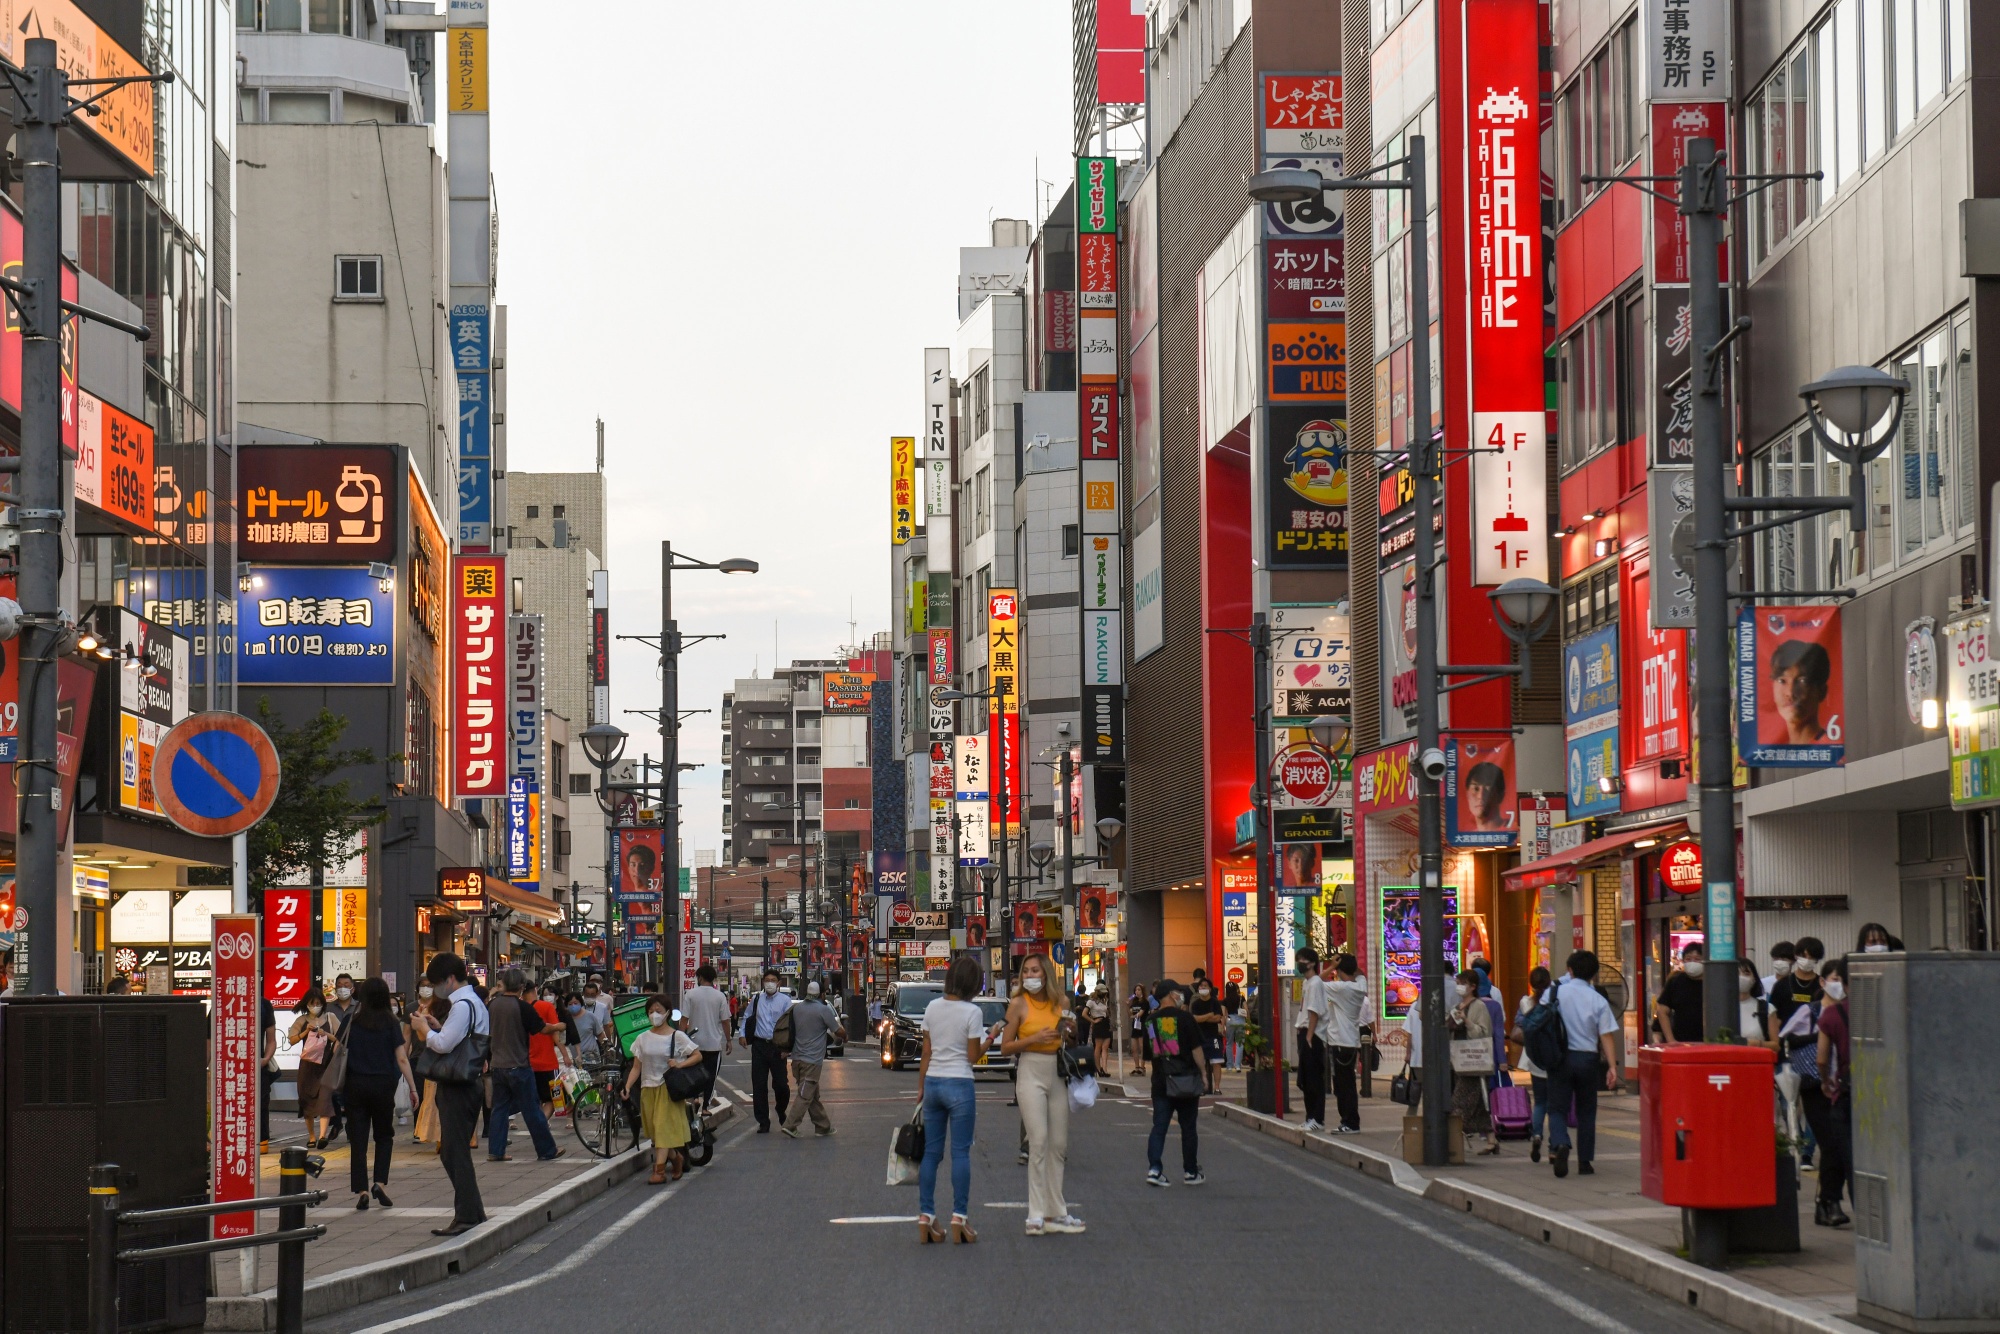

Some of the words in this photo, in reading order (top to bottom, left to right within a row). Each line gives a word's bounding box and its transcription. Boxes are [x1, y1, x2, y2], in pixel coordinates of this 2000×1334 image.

[459, 31, 474, 111] 大宮中央クリニック
[1702, 51, 1716, 87] 5F
[1478, 128, 1490, 210] TAITO
[1088, 161, 1106, 231] サイゼリヤ
[1492, 128, 1531, 328] GAME
[1085, 237, 1097, 291] バイキング
[1100, 235, 1111, 291] しゃぶしゃぶ
[1273, 247, 1344, 273] ホット
[1479, 214, 1493, 328] STATION
[453, 304, 487, 317] AEON
[1084, 293, 1114, 304] しゃぶ葉
[1083, 345, 1115, 353] コンタクト
[1300, 370, 1346, 392] PLUS
[457, 320, 483, 512] 英会話イーオン
[931, 404, 945, 451] TRN
[1090, 394, 1109, 455] ガスト
[111, 417, 145, 465] 生ビール
[247, 486, 329, 518] ドトール
[247, 522, 329, 543] 珈琲農園
[460, 525, 482, 540] 5F
[1494, 540, 1529, 570] 1F
[466, 568, 493, 595] 薬
[1135, 566, 1161, 614] RAKUUN
[258, 597, 373, 628] 回転寿司
[992, 597, 1014, 616] 質
[930, 630, 951, 638] 麻雀
[1096, 616, 1108, 683] RAKUUN
[1740, 621, 1754, 661] AKINARI
[147, 638, 172, 671] ダーツBAR
[516, 622, 536, 702] パチンコ
[596, 638, 607, 680] union
[934, 638, 947, 683] ウエルカム
[992, 626, 1014, 696] 大黒屋
[839, 675, 862, 684] THE
[1642, 649, 1678, 729] GAME
[1740, 666, 1755, 722] KAWAZURA
[148, 684, 171, 712] REGALO
[464, 605, 495, 789] サンドラッグ
[930, 716, 952, 730] UP
[1095, 694, 1113, 756] DOUTOR
[1826, 714, 1842, 741] 6
[964, 753, 981, 785] 松のや
[1446, 749, 1456, 767] YUTA
[1753, 749, 1831, 762] 大宮銀座商店街
[124, 763, 135, 780] STOP
[1285, 765, 1327, 786] 消火栓
[1446, 770, 1456, 797] MIKADO
[1285, 829, 1333, 837] GRANDE
[1505, 810, 1515, 829] 7
[1454, 833, 1510, 843] 大宮銀座商店街
[443, 879, 467, 889] ドトール
[647, 878, 660, 891] 37
[1314, 872, 1321, 884] 8
[1669, 863, 1703, 881] GAME
[650, 903, 660, 913] 18
[1100, 918, 1105, 927] 9
[19, 931, 29, 974] 路上喫煙
[274, 895, 299, 996] カラオケ
[225, 976, 236, 1175] ポイ捨ては禁止です。
[236, 976, 248, 1177] 路上喫煙・空き缶等の
